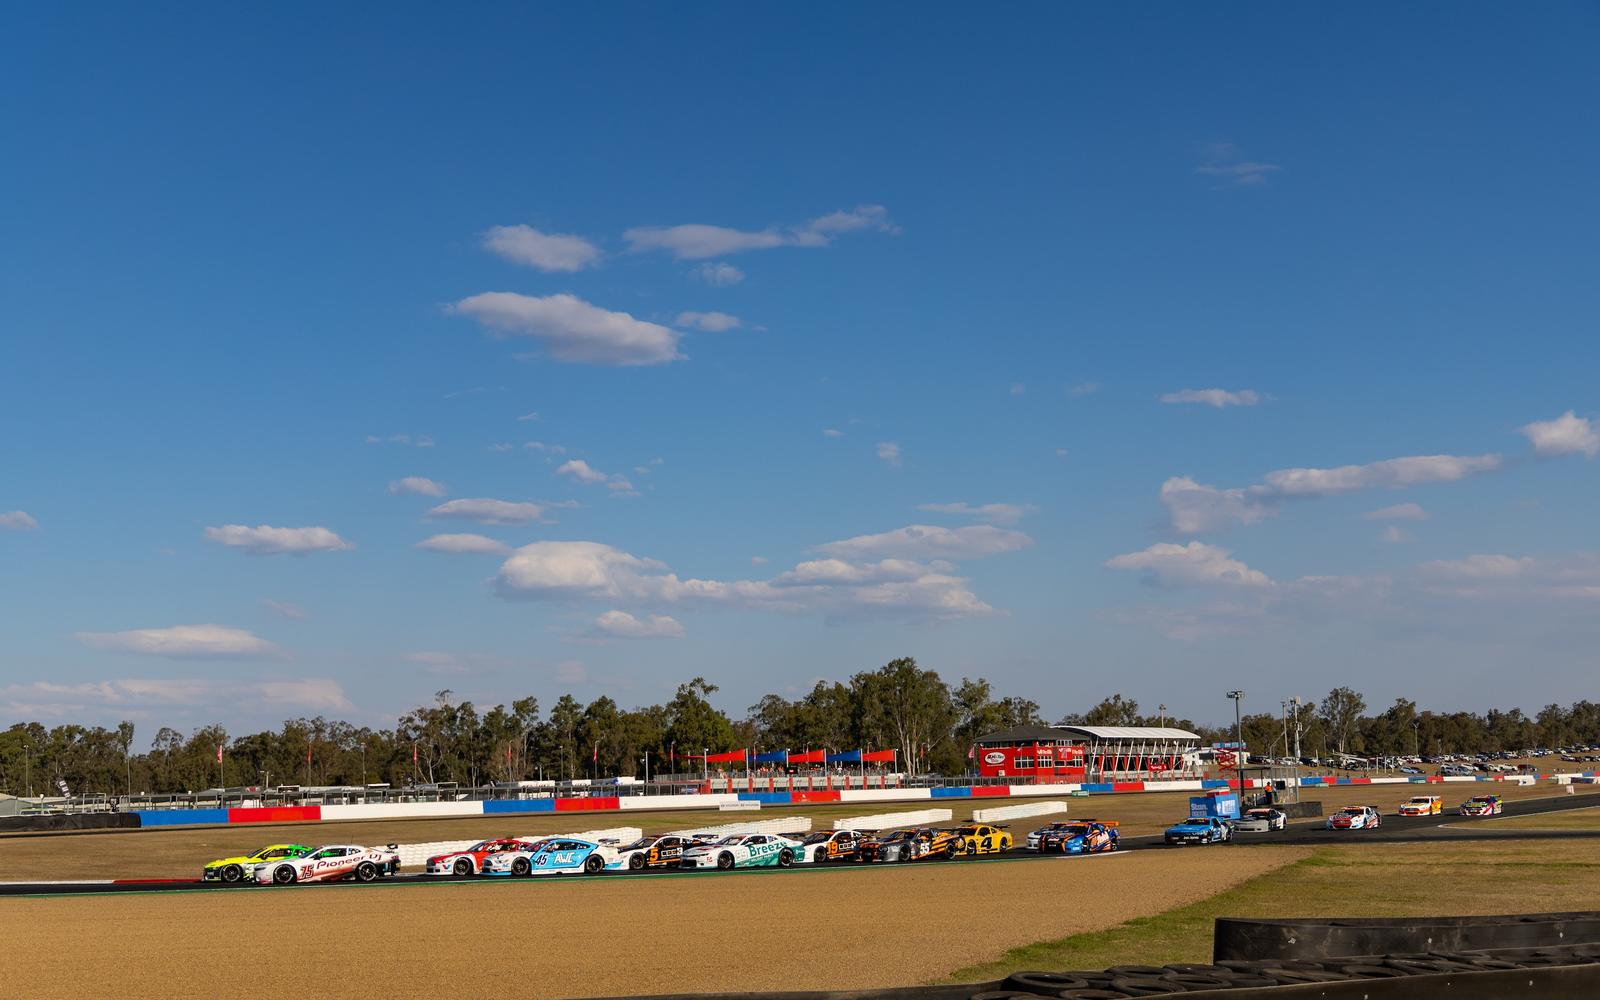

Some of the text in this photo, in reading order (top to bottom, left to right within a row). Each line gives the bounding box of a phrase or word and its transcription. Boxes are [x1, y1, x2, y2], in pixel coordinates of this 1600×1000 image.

[920, 843, 930, 854] 55
[981, 836, 992, 850] 4
[316, 855, 364, 869] Pioneer
[535, 854, 548, 866] 45
[300, 864, 314, 879] 75
